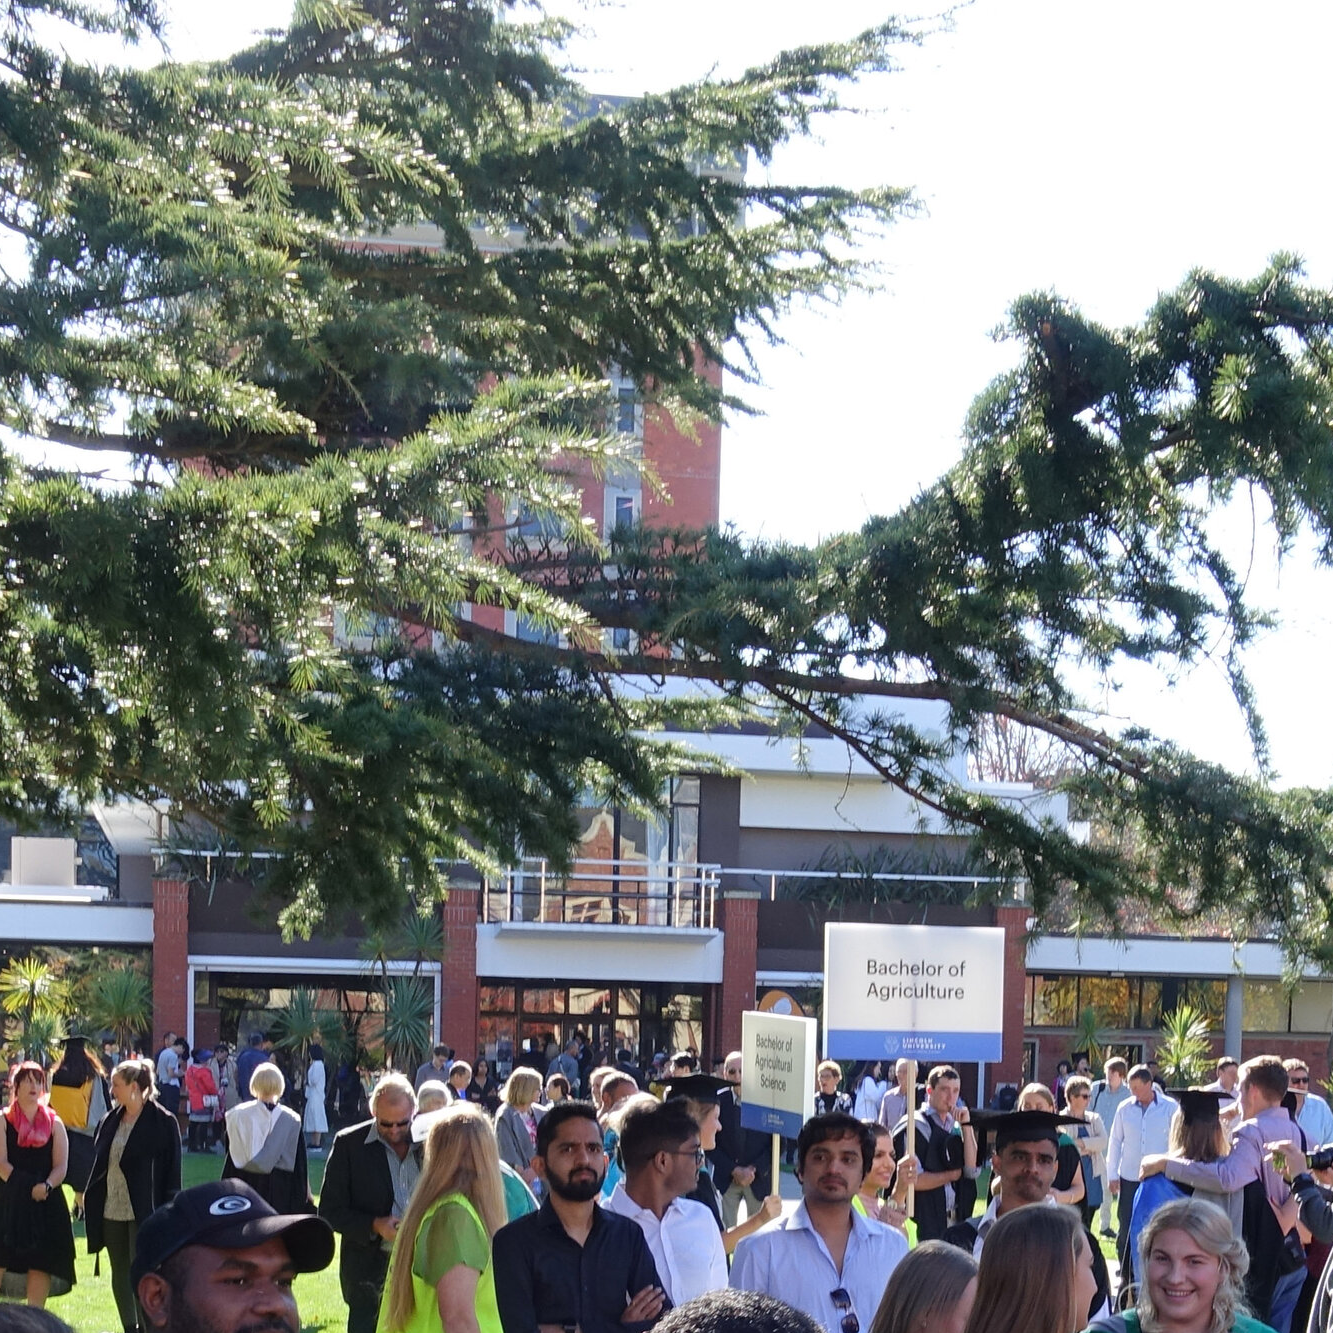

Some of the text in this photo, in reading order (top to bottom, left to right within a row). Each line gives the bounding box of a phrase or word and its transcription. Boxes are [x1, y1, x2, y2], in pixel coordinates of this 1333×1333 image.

[866, 958, 966, 977] Bachelor of
[866, 981, 965, 1002] Agriculture
[755, 1033, 793, 1053] Bachelor of
[754, 1053, 793, 1073] Agricultural
[760, 1073, 787, 1092] Science
